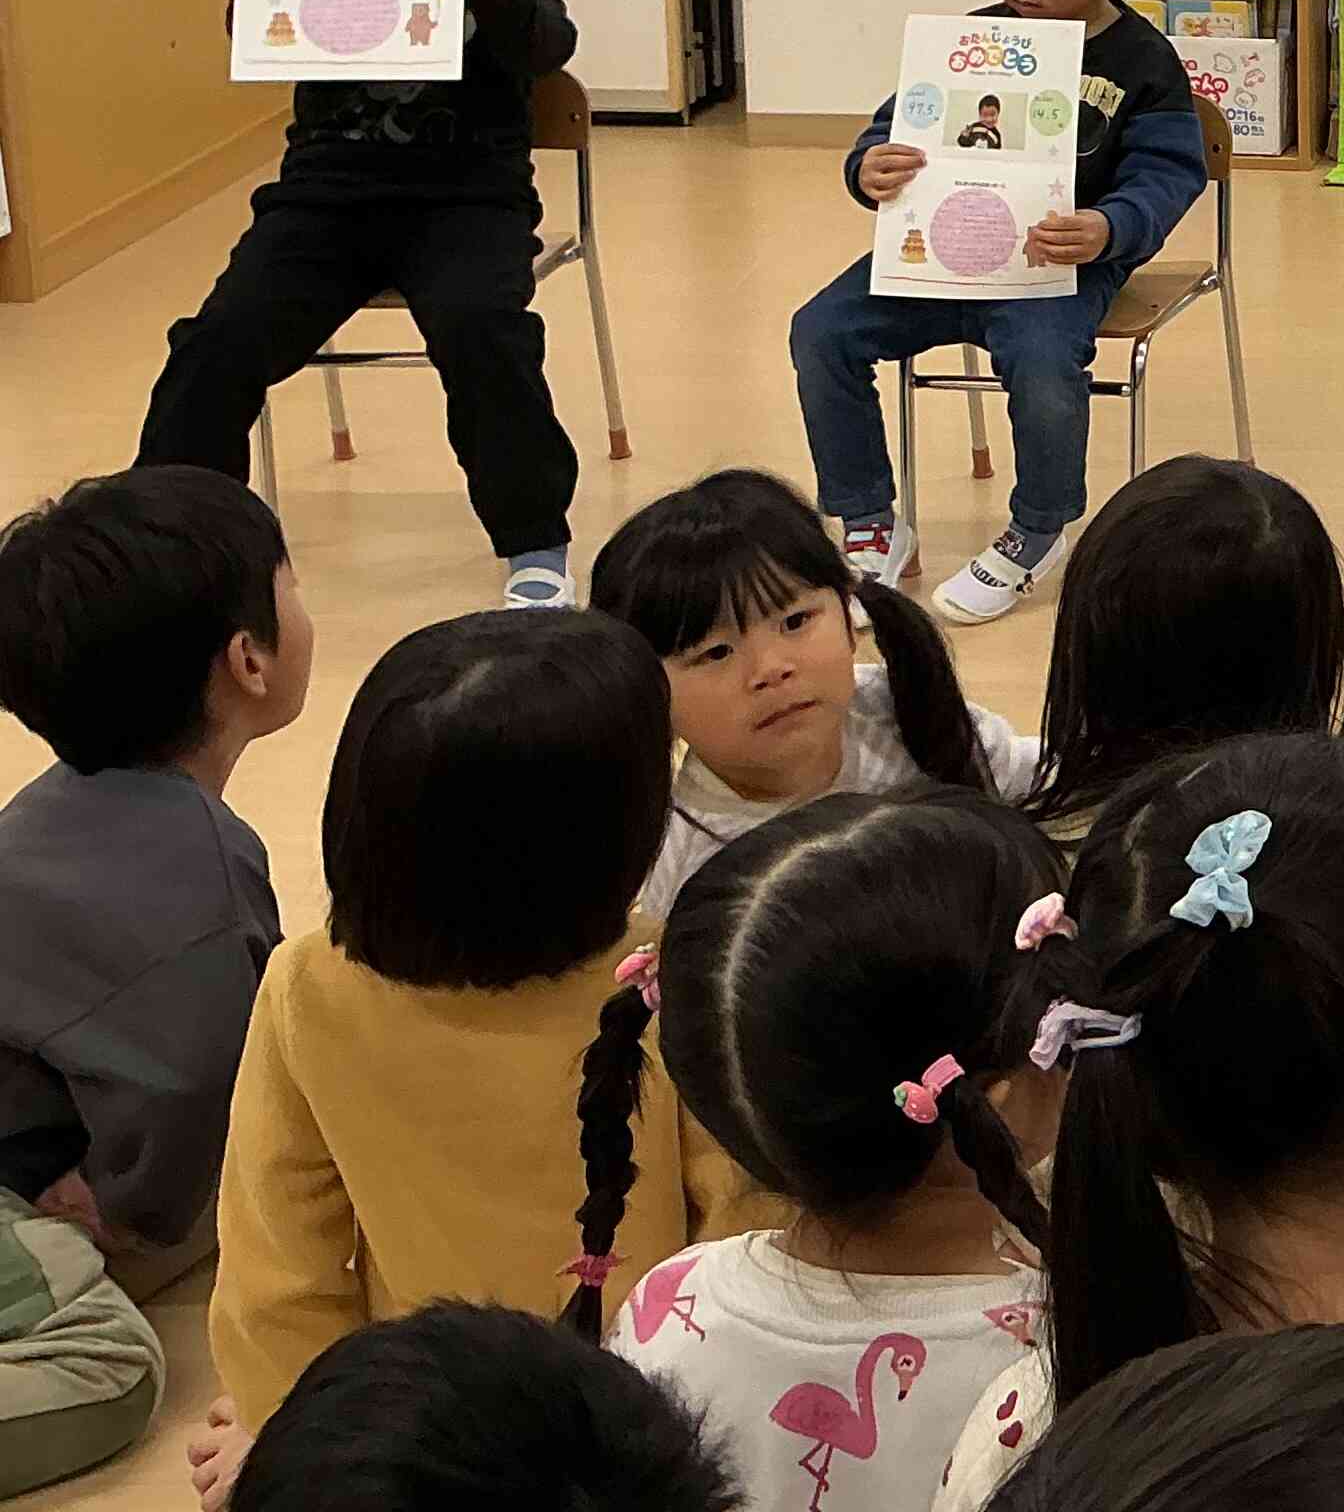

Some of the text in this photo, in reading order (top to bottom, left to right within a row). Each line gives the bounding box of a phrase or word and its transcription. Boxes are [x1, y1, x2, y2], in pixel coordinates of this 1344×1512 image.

[958, 32, 1033, 49] おたんじょうび
[948, 45, 1038, 76] おめでとう
